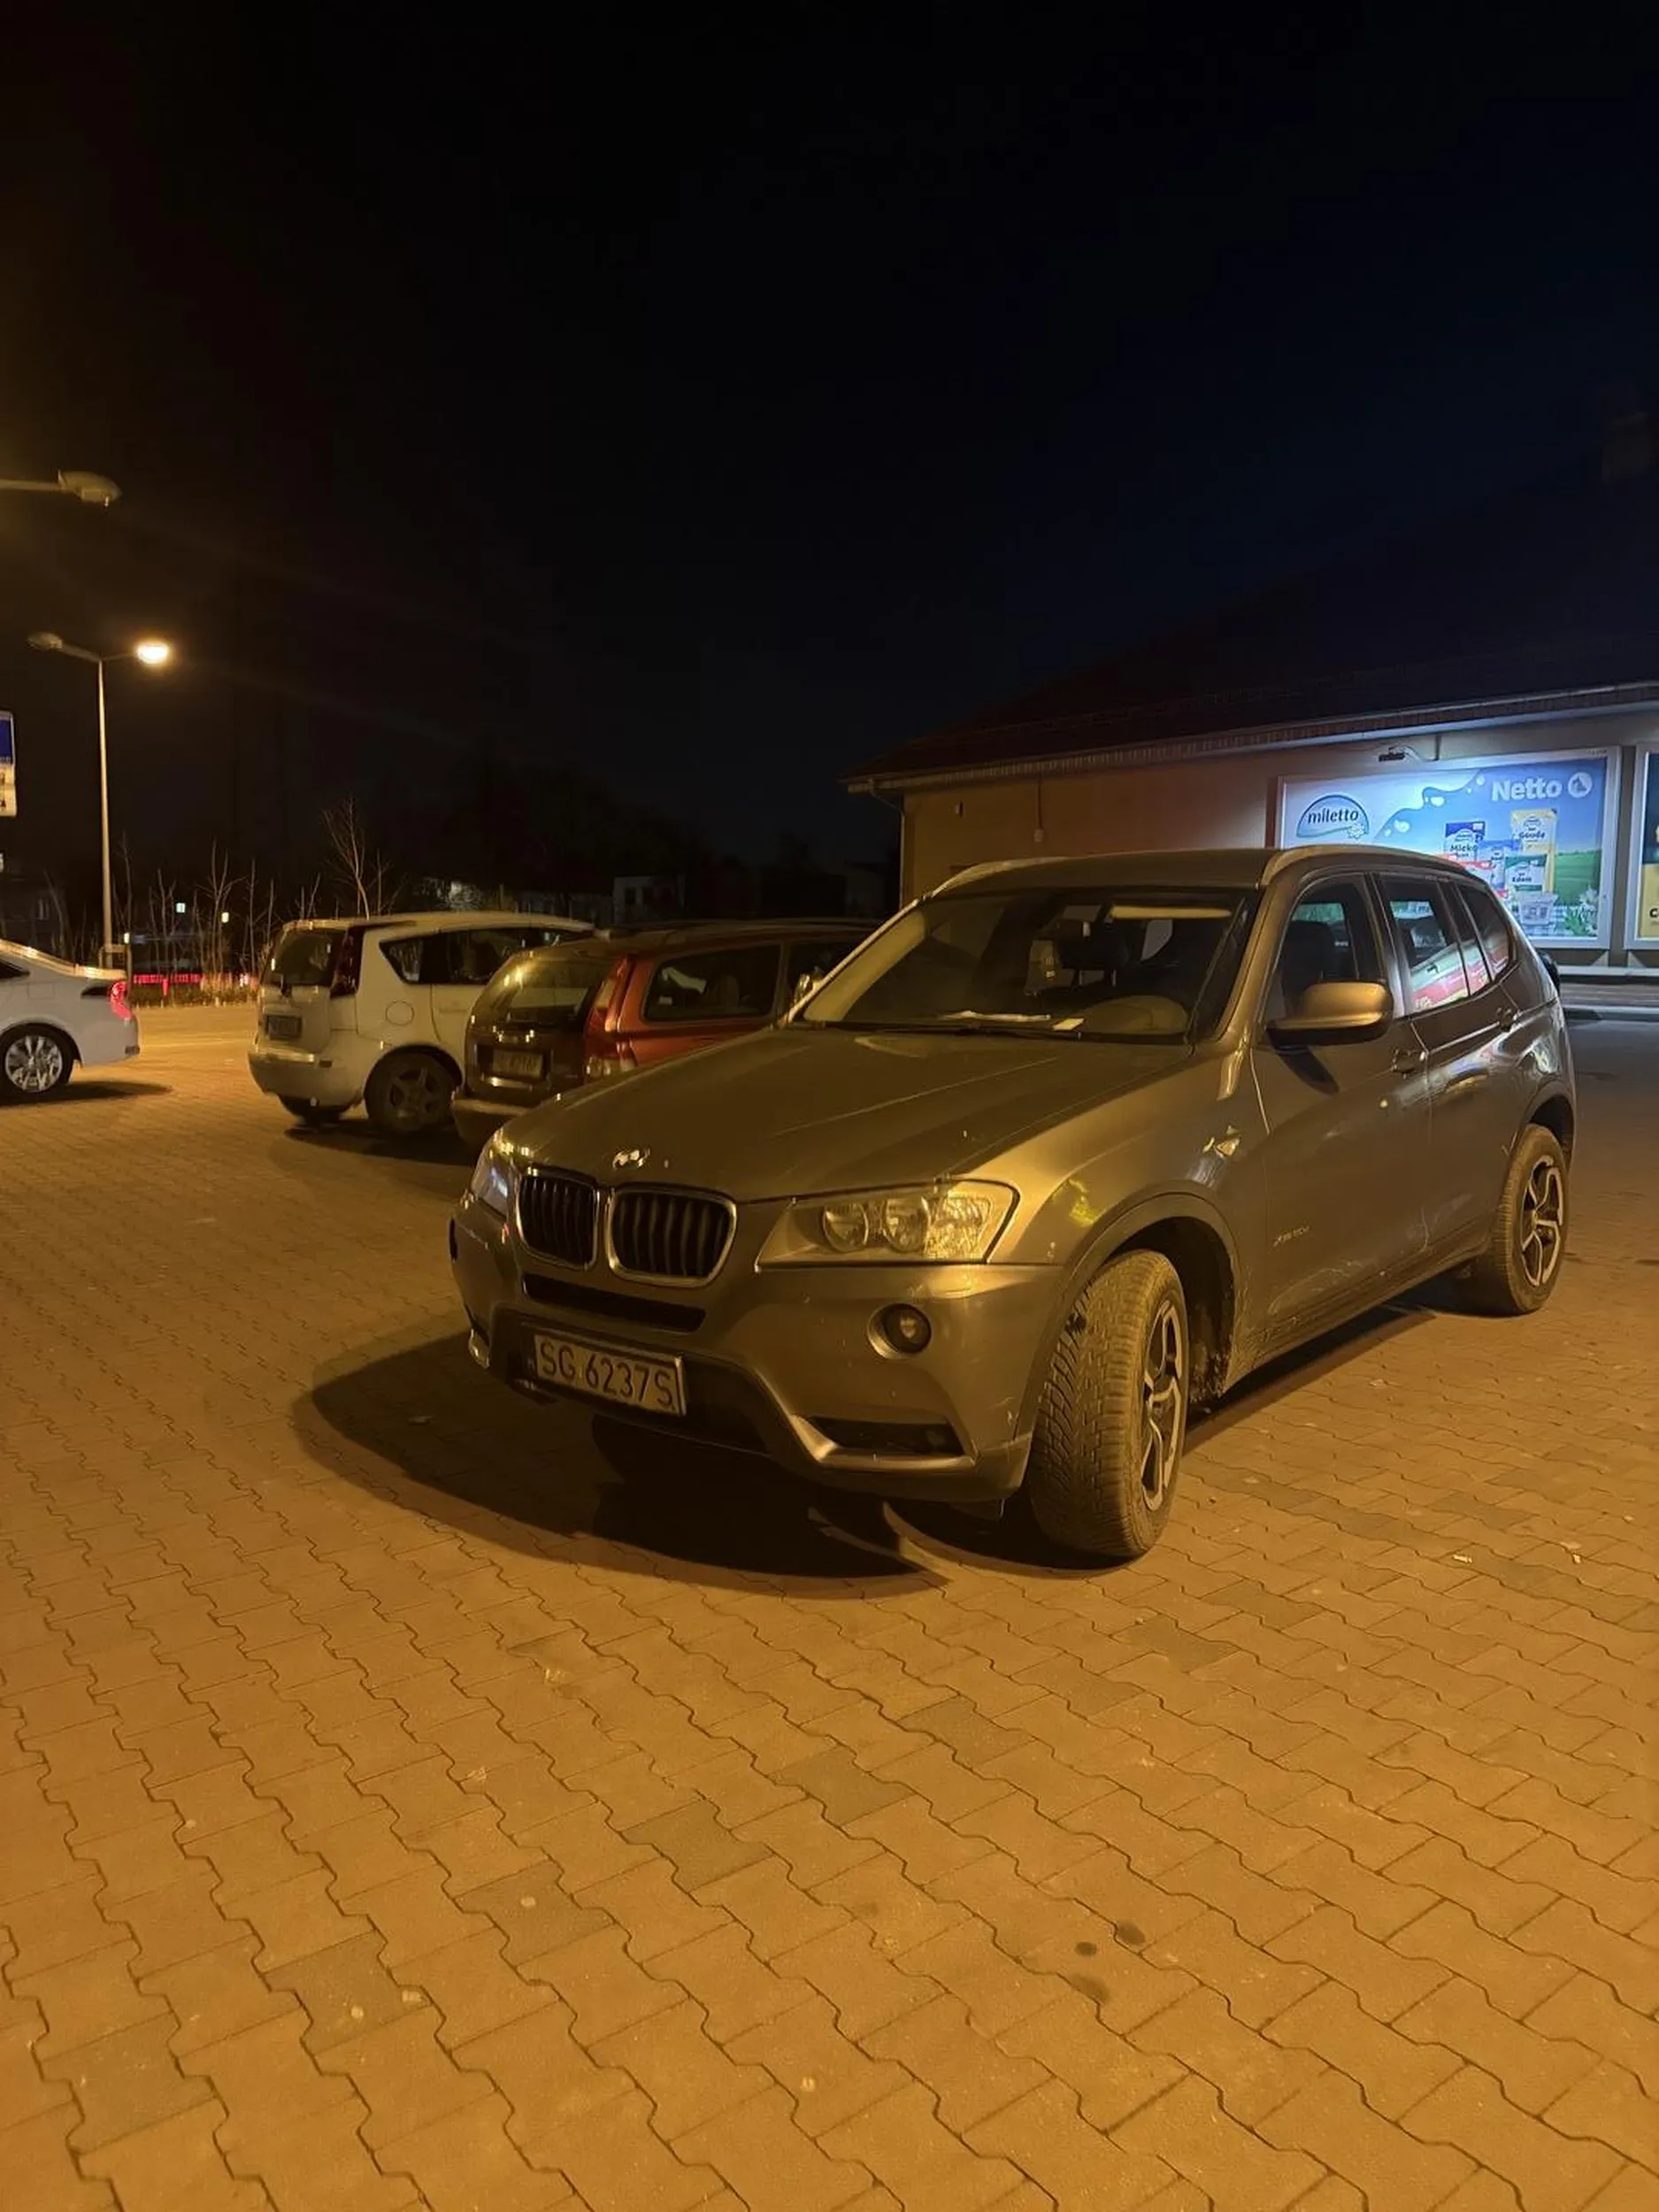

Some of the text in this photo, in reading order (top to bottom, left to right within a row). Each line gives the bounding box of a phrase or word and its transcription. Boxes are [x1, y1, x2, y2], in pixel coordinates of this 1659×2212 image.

[1492, 777, 1563, 802] Netto
[1308, 808, 1359, 824] miletto
[541, 1340, 673, 1407] SG 6237S
